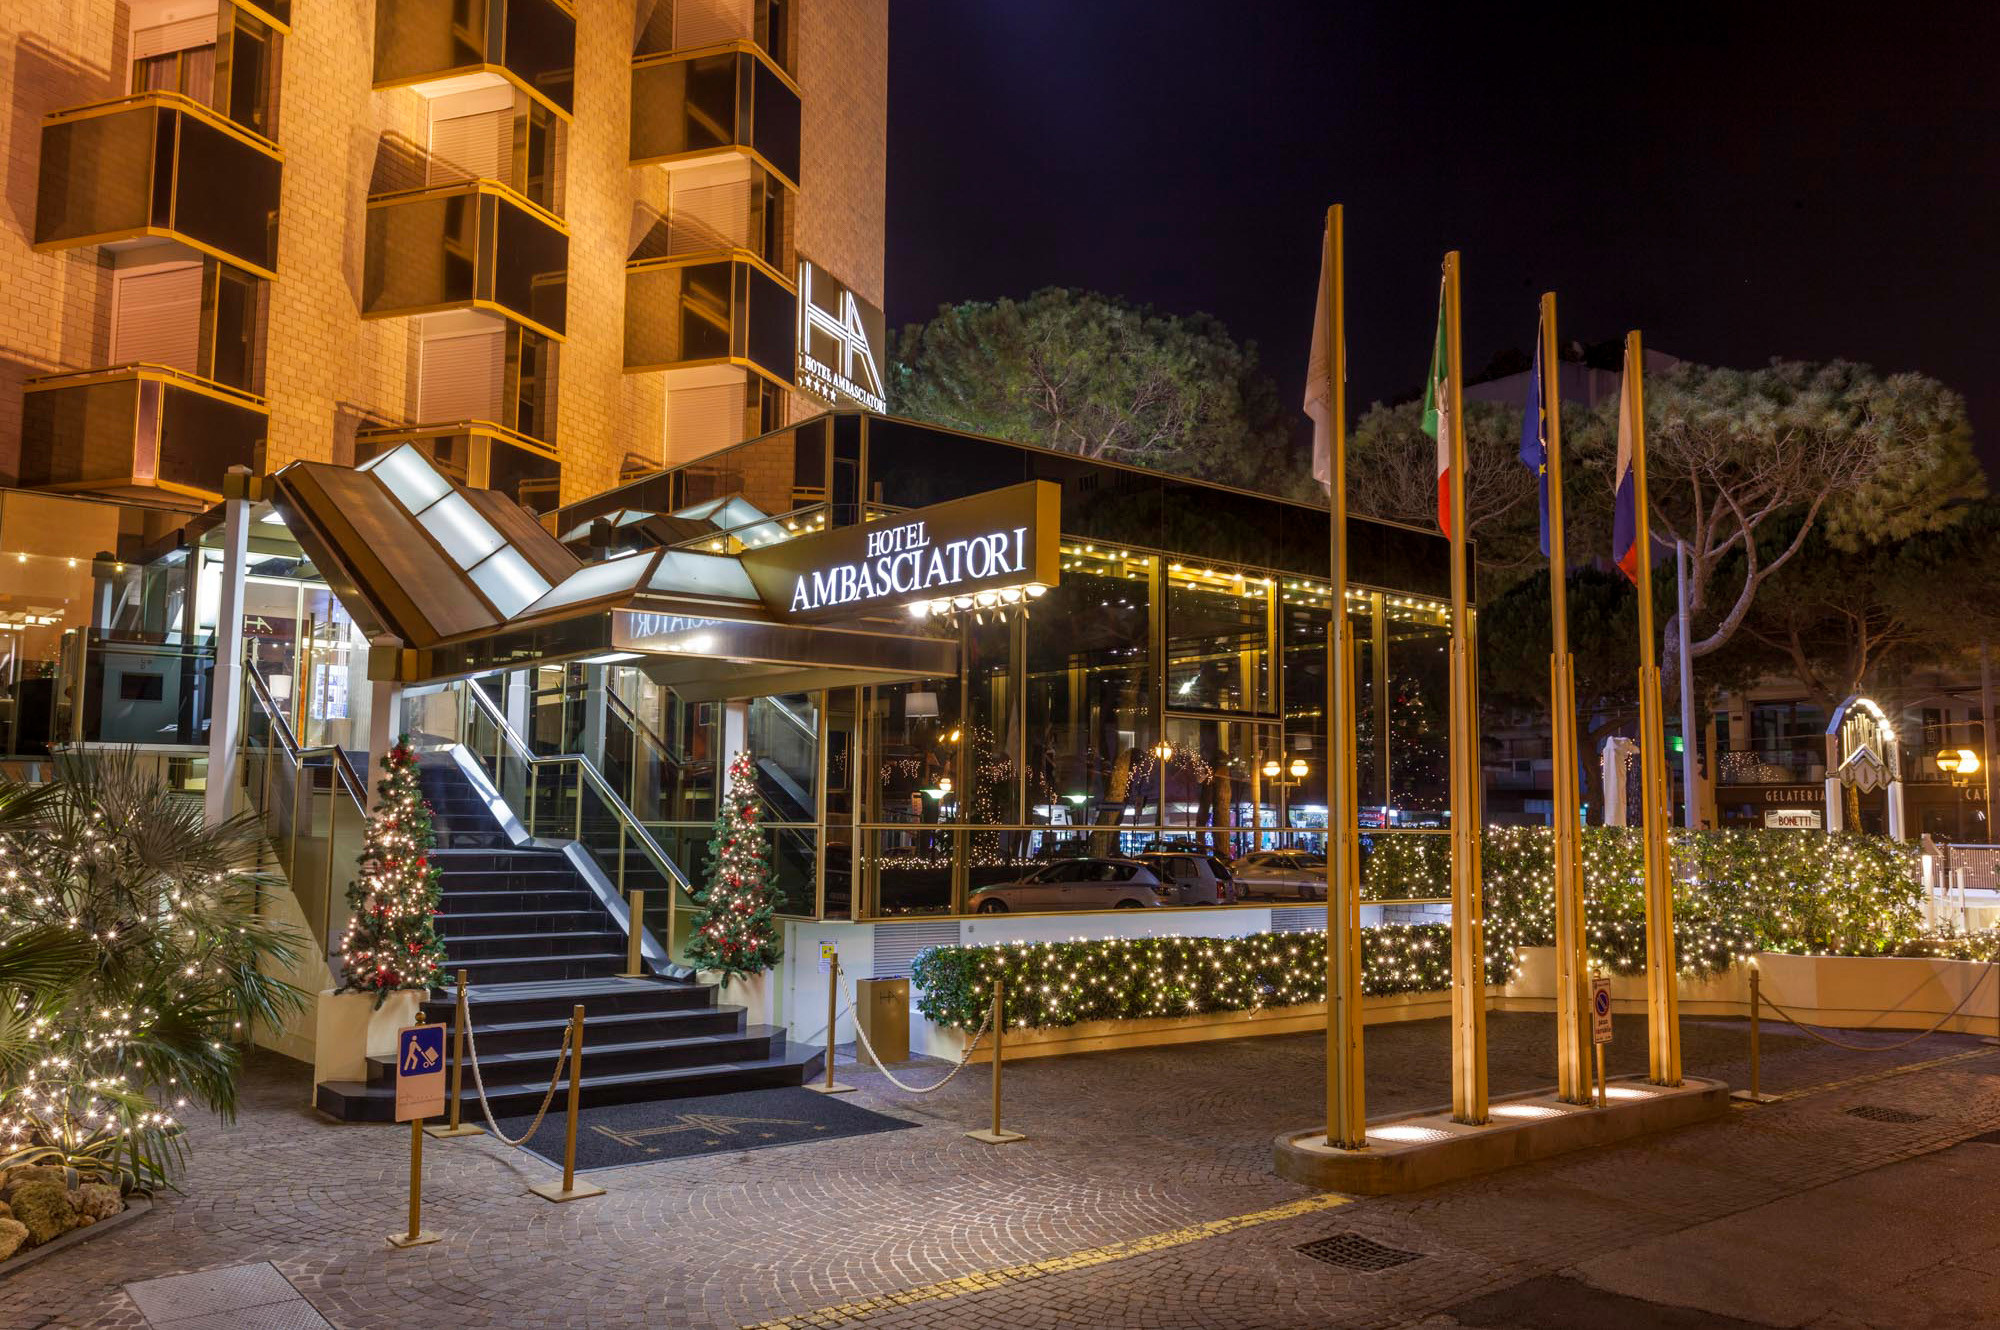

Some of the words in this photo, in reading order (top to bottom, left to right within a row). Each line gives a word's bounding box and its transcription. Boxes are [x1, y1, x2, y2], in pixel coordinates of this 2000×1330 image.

[805, 354, 832, 383] HOTEL
[833, 372, 886, 415] AMBASCIATORI
[866, 521, 930, 558] HOTEL
[789, 527, 1027, 612] AMBASCIATORI
[1765, 790, 1825, 802] GELATERIA
[1778, 815, 1812, 827] BONETTI
